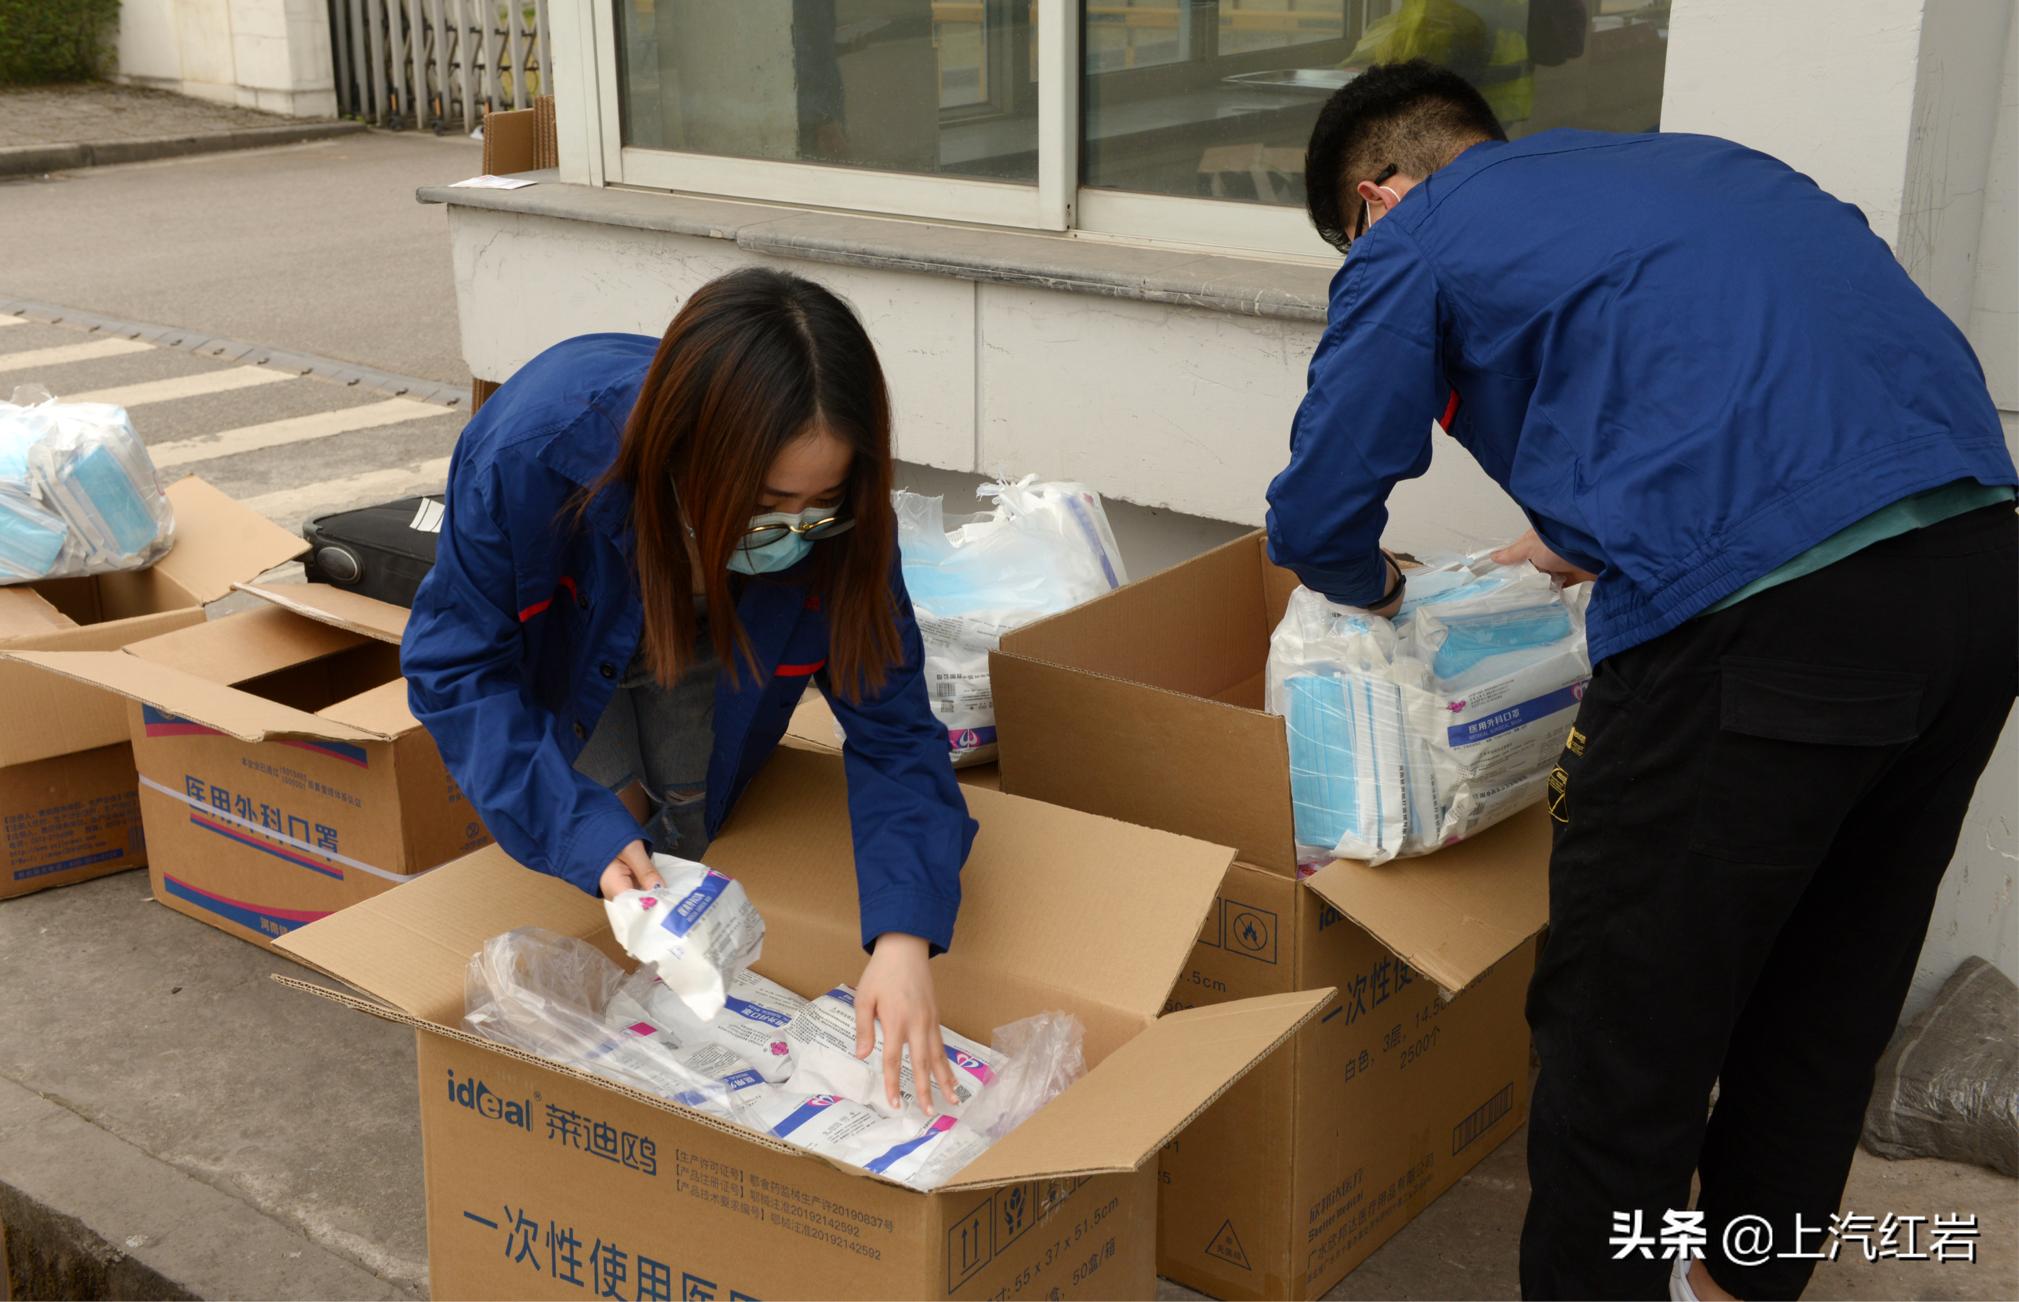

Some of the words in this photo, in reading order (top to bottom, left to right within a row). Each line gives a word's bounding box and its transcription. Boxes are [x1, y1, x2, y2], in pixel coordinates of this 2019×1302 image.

[1469, 708, 1520, 734] 医用外科口罩
[185, 774, 339, 862] 医用外科口罩
[1322, 955, 1421, 1026] 一次性使
[1399, 1025, 1441, 1070] 2500个
[447, 1068, 533, 1132] ideal
[545, 1103, 657, 1176] 莱迪鸥
[463, 1204, 763, 1302] 一次性使用医
[1015, 1268, 1031, 1293] 55
[1074, 1197, 1119, 1241] 51.5cm
